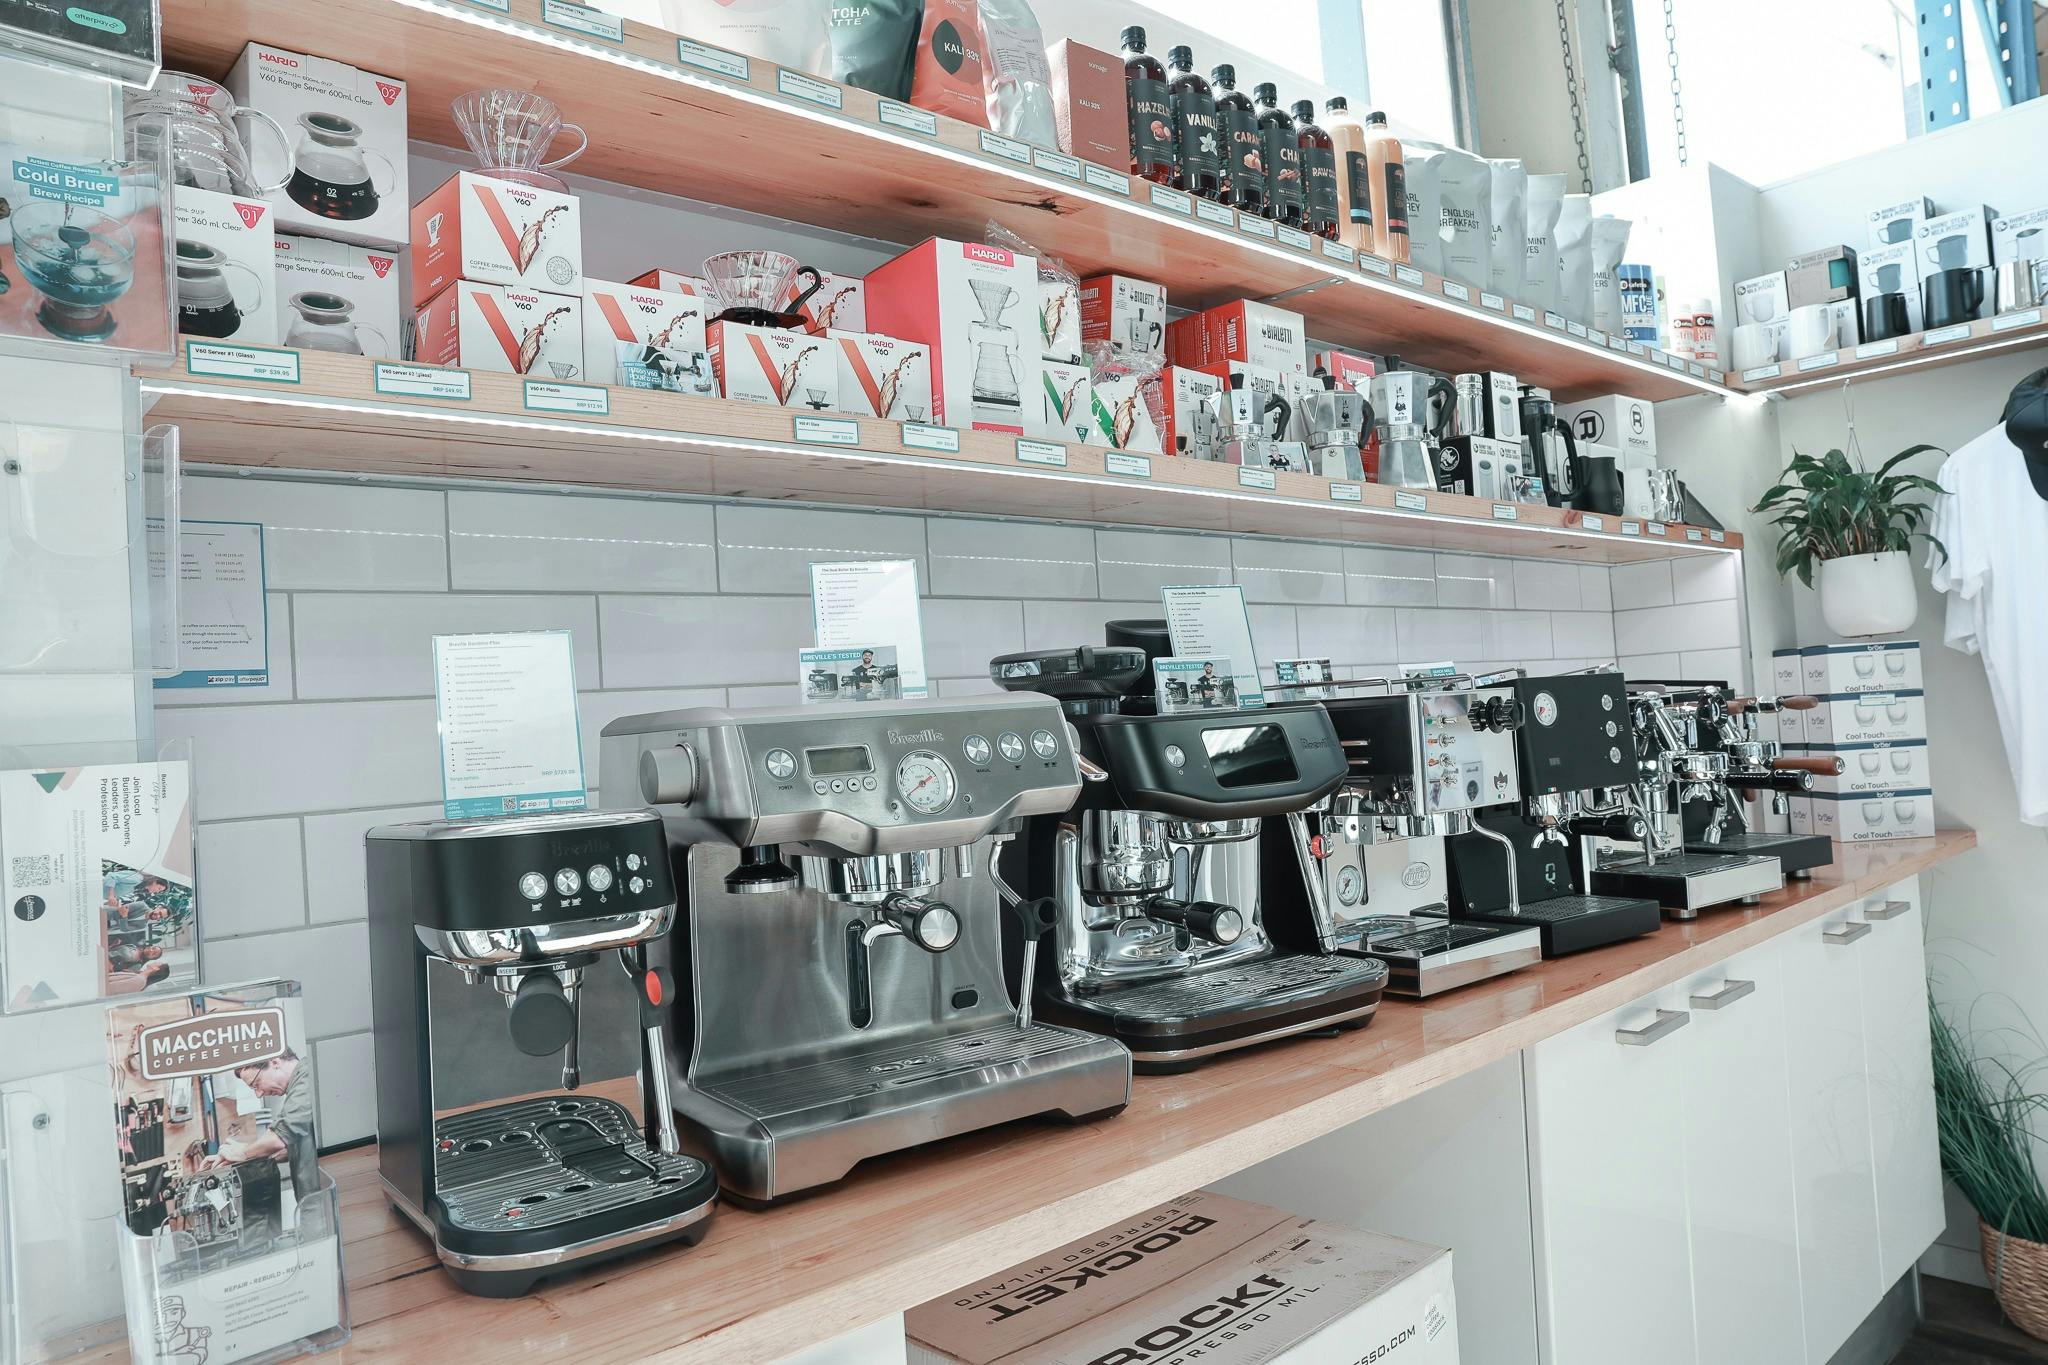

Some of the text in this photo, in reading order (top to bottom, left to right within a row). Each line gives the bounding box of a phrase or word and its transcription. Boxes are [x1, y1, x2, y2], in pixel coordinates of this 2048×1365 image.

[74, 12, 109, 27] afterpay
[944, 42, 981, 64] KALI 33%
[258, 52, 298, 68] HARIO
[259, 73, 374, 106] V60 Range Server 600mL Clear
[382, 88, 396, 100] 02
[18, 166, 114, 192] Cold Bruer
[1312, 168, 1328, 178] RAW
[34, 187, 100, 206] Brew Recipe
[506, 187, 537, 200] HARIO
[514, 197, 531, 207] V60
[242, 210, 258, 222] 01
[1442, 208, 1475, 219] ENGLISH
[191, 217, 242, 232] 360 mL Clear
[971, 248, 1006, 262] HARIO
[296, 263, 319, 274] Server
[320, 268, 346, 278] 600mL
[346, 272, 366, 280] Clear
[373, 262, 388, 272] 02
[507, 293, 538, 304] HARIO
[630, 294, 664, 307] HARIO
[1134, 290, 1155, 306] BIALETTI
[1622, 294, 1646, 314] MFC
[514, 302, 532, 311] V60
[639, 304, 658, 314] V60
[770, 334, 794, 344] HARIO
[1266, 324, 1293, 345] BIALETTI
[776, 341, 790, 350] V60
[868, 338, 894, 349] HARIO
[208, 348, 225, 357] Server
[874, 348, 888, 356] V60
[1104, 372, 1120, 382] V60
[1862, 684, 1884, 692] Touch
[1863, 731, 1885, 740] Touch
[1850, 780, 1890, 790] Cool Touch
[133, 776, 142, 816] Join Local
[100, 778, 109, 832] Professionals
[112, 778, 120, 830] Leaders, and
[122, 777, 131, 847] Business Owners,
[1871, 830, 1893, 838] Touch
[152, 1020, 272, 1057] MACCHINA
[152, 1039, 275, 1069] COFFEE TECH
[954, 1209, 1180, 1307] ESPRESSO MILANO
[991, 1214, 1218, 1322] ROCKET
[224, 1281, 248, 1294] REPAIR
[1278, 1284, 1322, 1308] MIL
